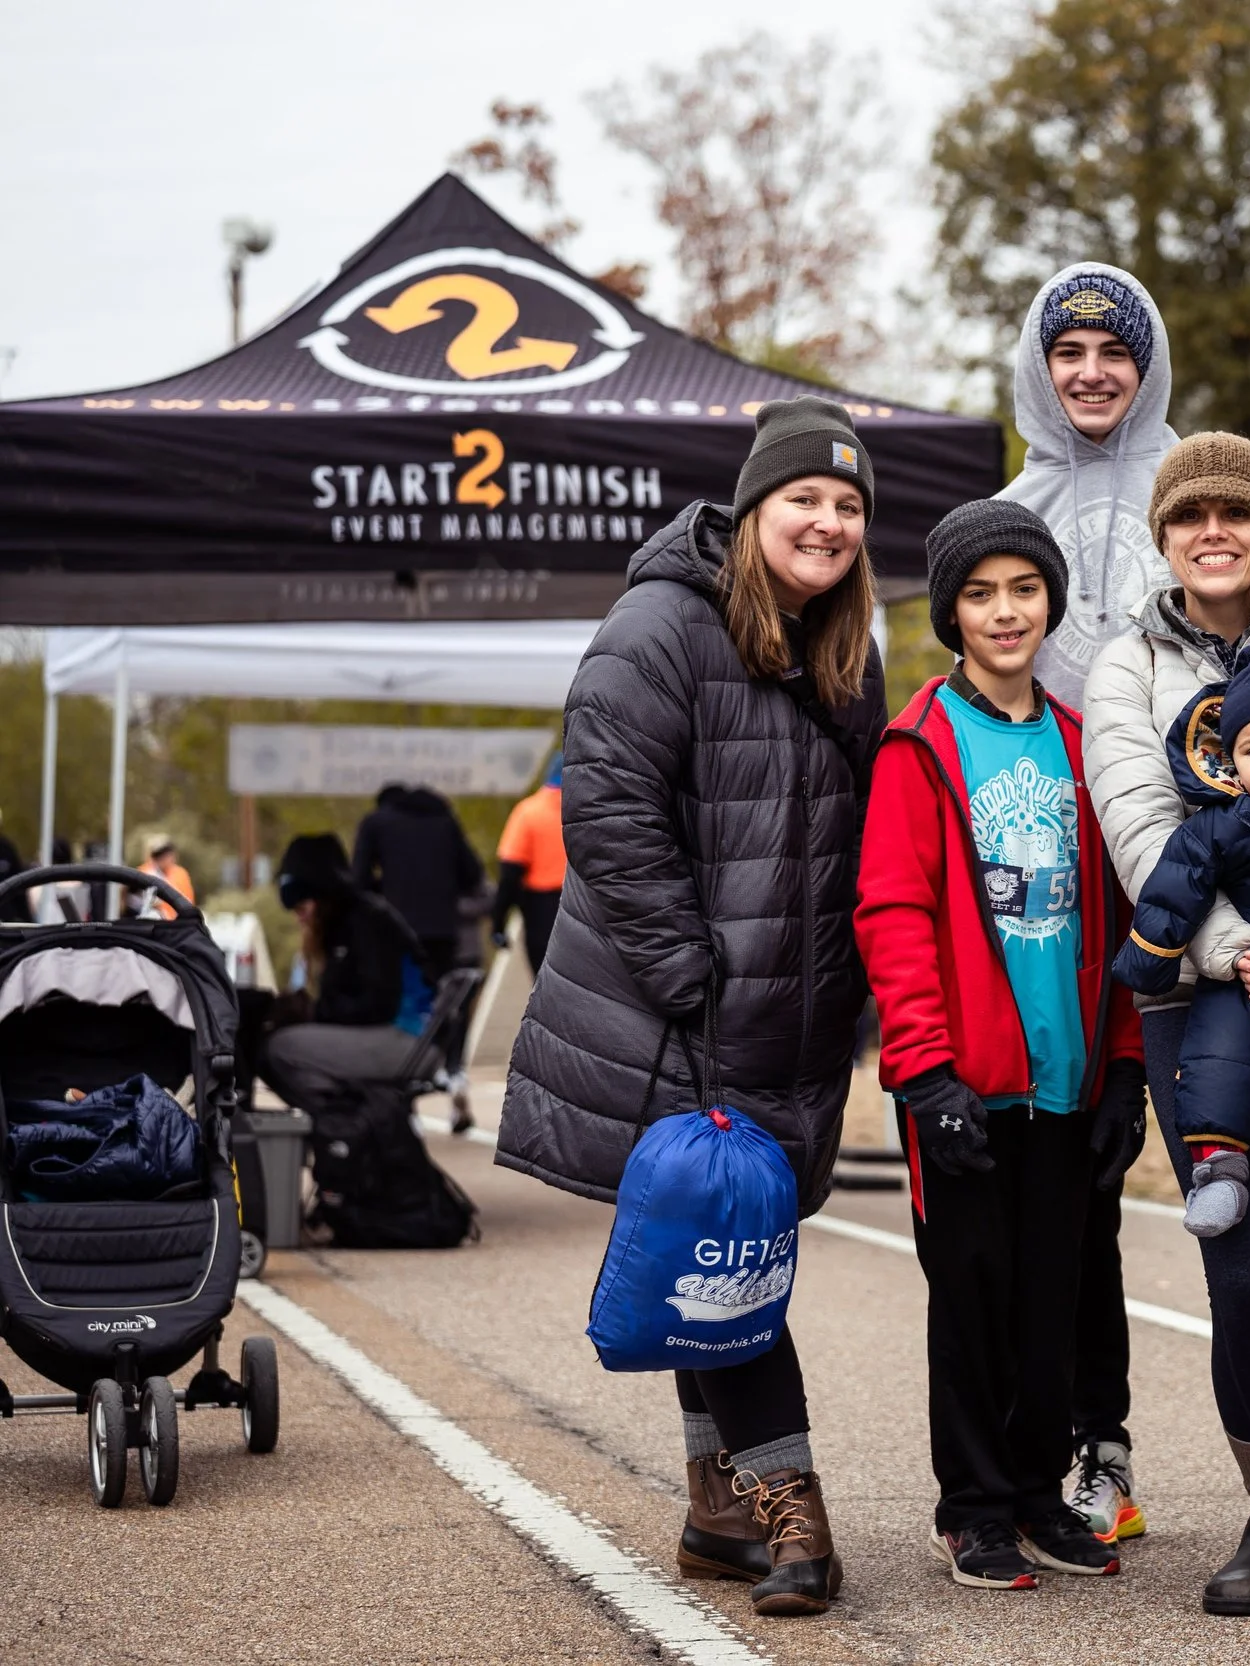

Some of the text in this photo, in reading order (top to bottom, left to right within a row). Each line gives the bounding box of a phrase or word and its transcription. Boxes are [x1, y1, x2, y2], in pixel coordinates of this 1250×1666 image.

[331, 513, 645, 542] EVENT MANAGEMENT
[1024, 872, 1034, 880] 5K
[991, 902, 1010, 911] EET
[88, 1320, 111, 1333] city
[113, 1319, 141, 1329] mini
[665, 1329, 773, 1352] gamemphis.org
